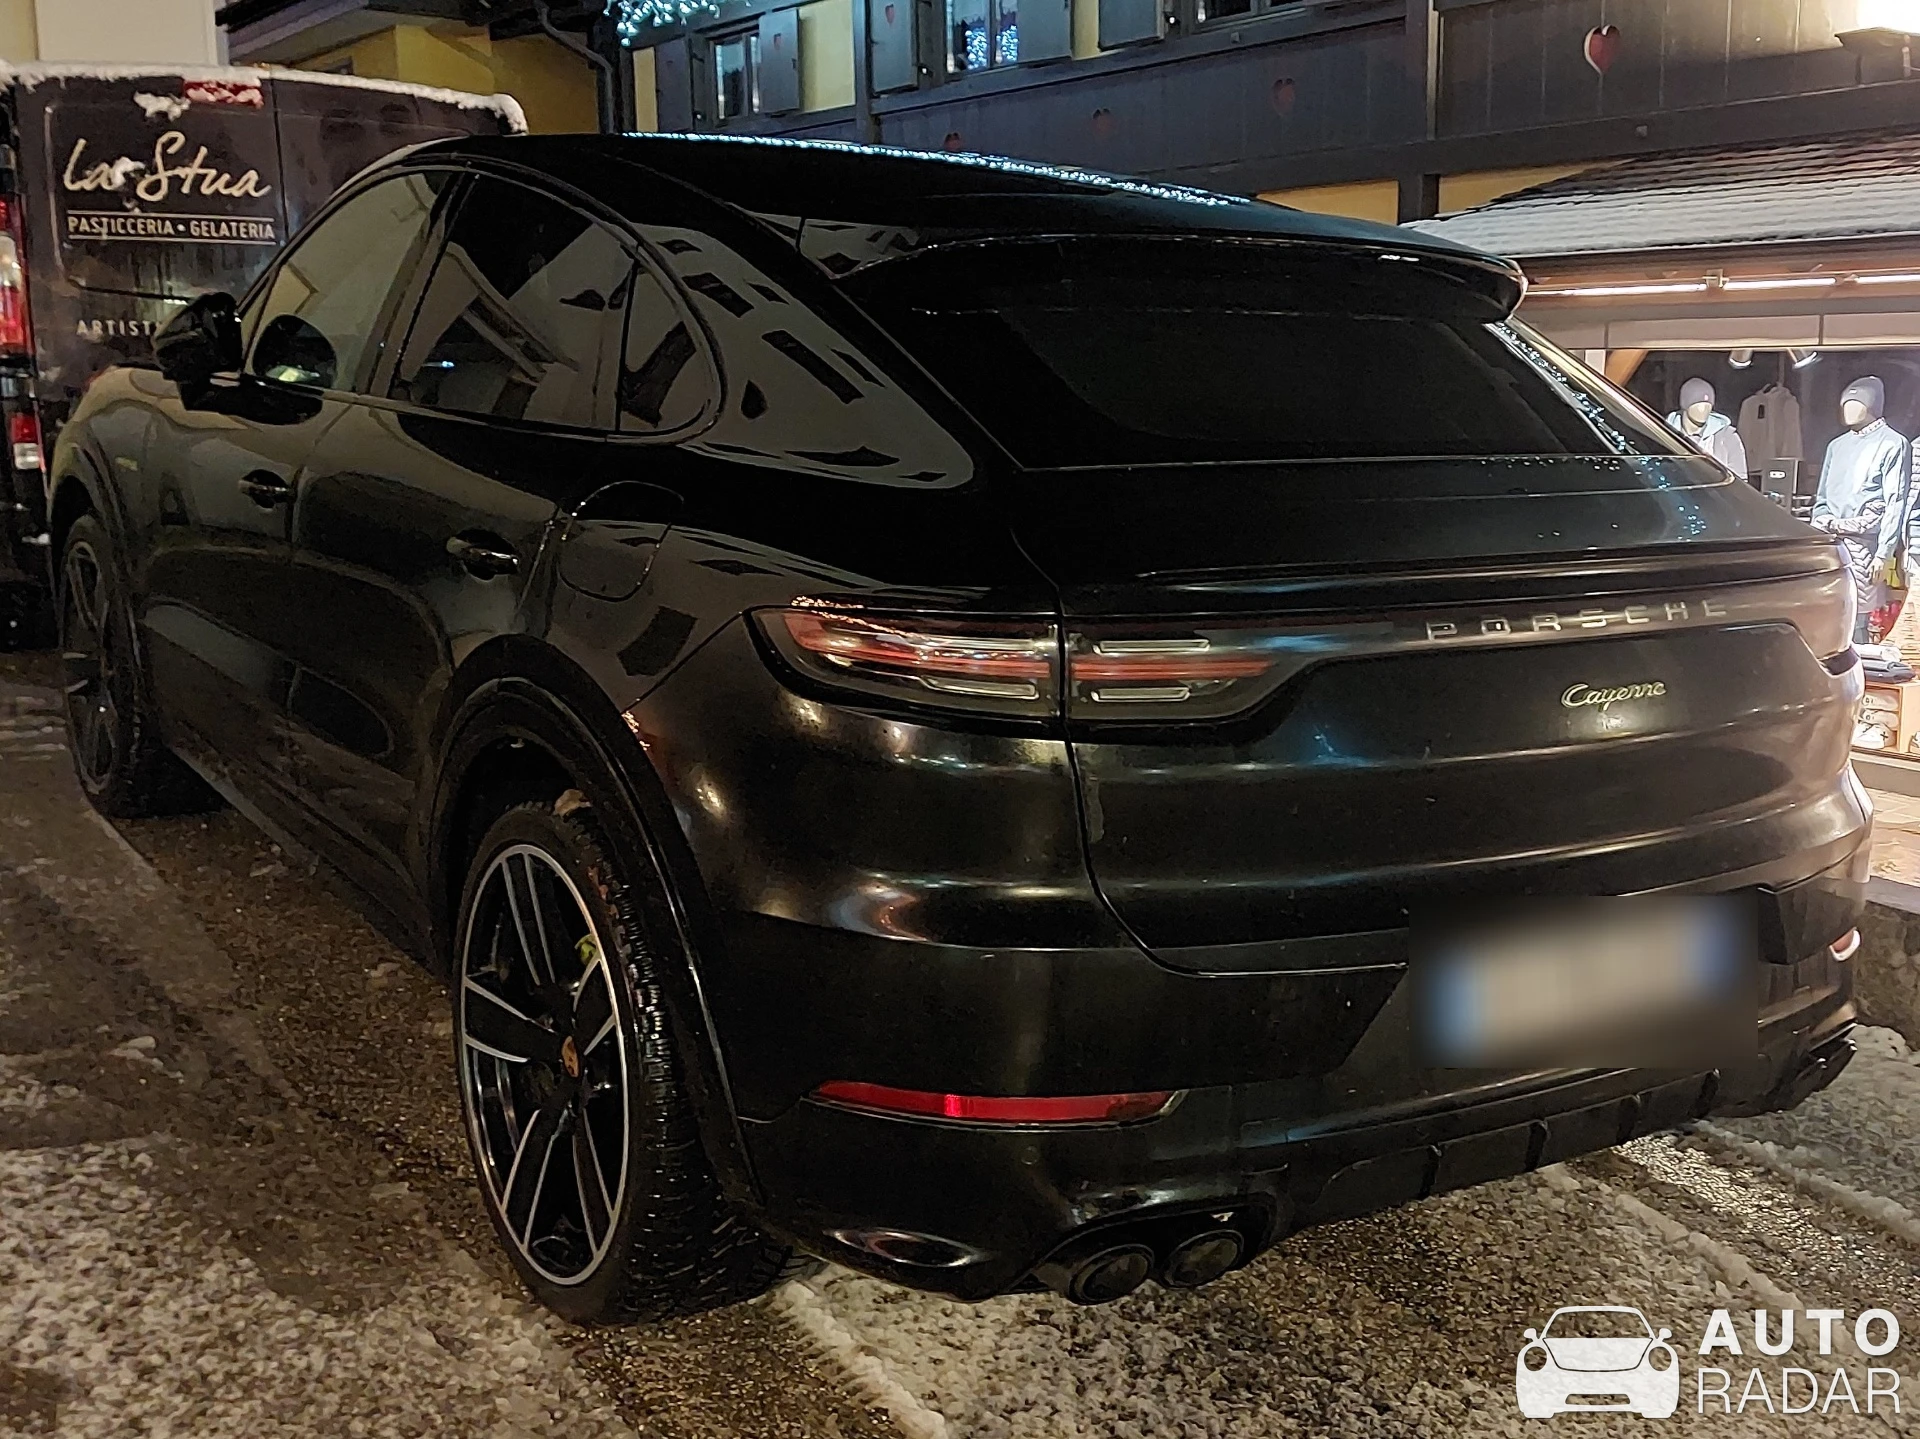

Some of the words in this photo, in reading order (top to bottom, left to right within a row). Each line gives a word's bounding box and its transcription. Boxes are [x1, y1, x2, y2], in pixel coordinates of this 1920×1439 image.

[136, 130, 272, 201] Stua
[67, 216, 175, 236] PASTICCERIA
[189, 220, 276, 239] GELATERIA
[1426, 600, 1727, 640] PORSCHE
[1561, 680, 1666, 711] Cayenne
